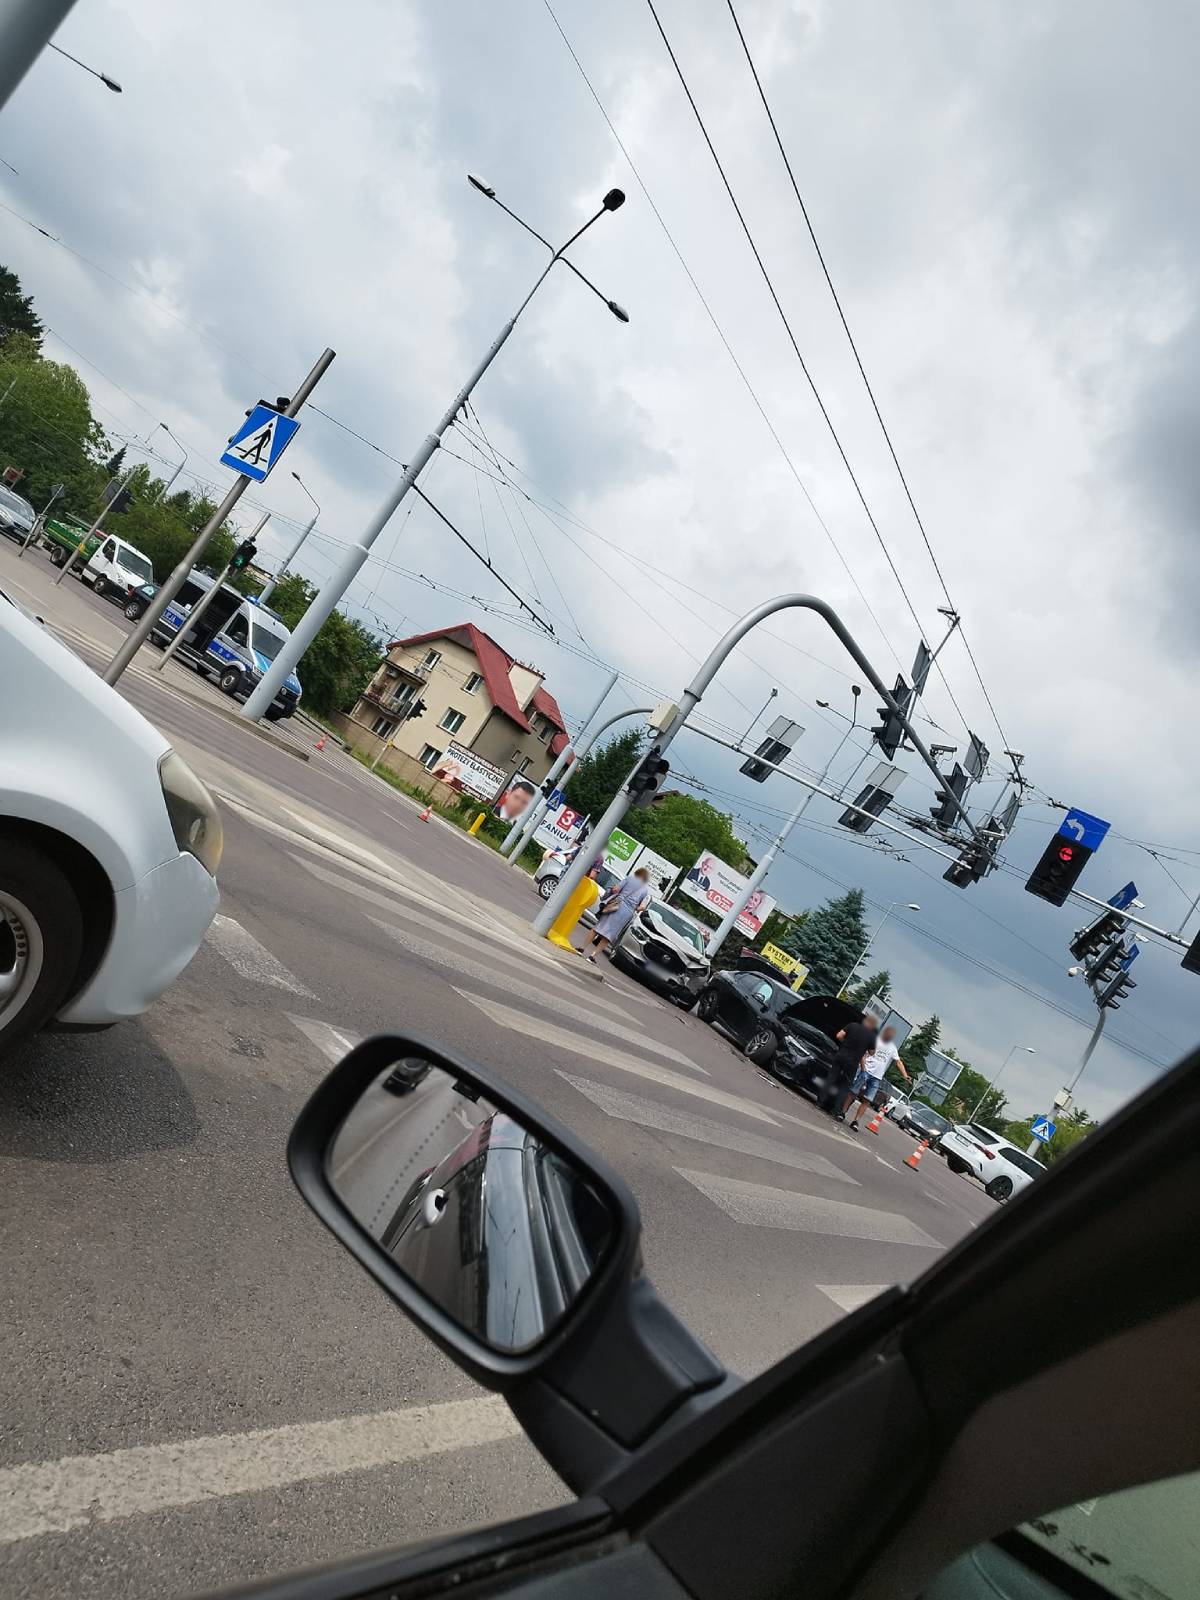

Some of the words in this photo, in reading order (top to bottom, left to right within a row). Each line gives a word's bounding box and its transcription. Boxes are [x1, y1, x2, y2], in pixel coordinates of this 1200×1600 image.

[447, 748, 469, 766] PROTEZY
[469, 762, 504, 786] ELASTYCZNE
[561, 810, 575, 826] 3
[768, 945, 793, 965] SYSTEMY
